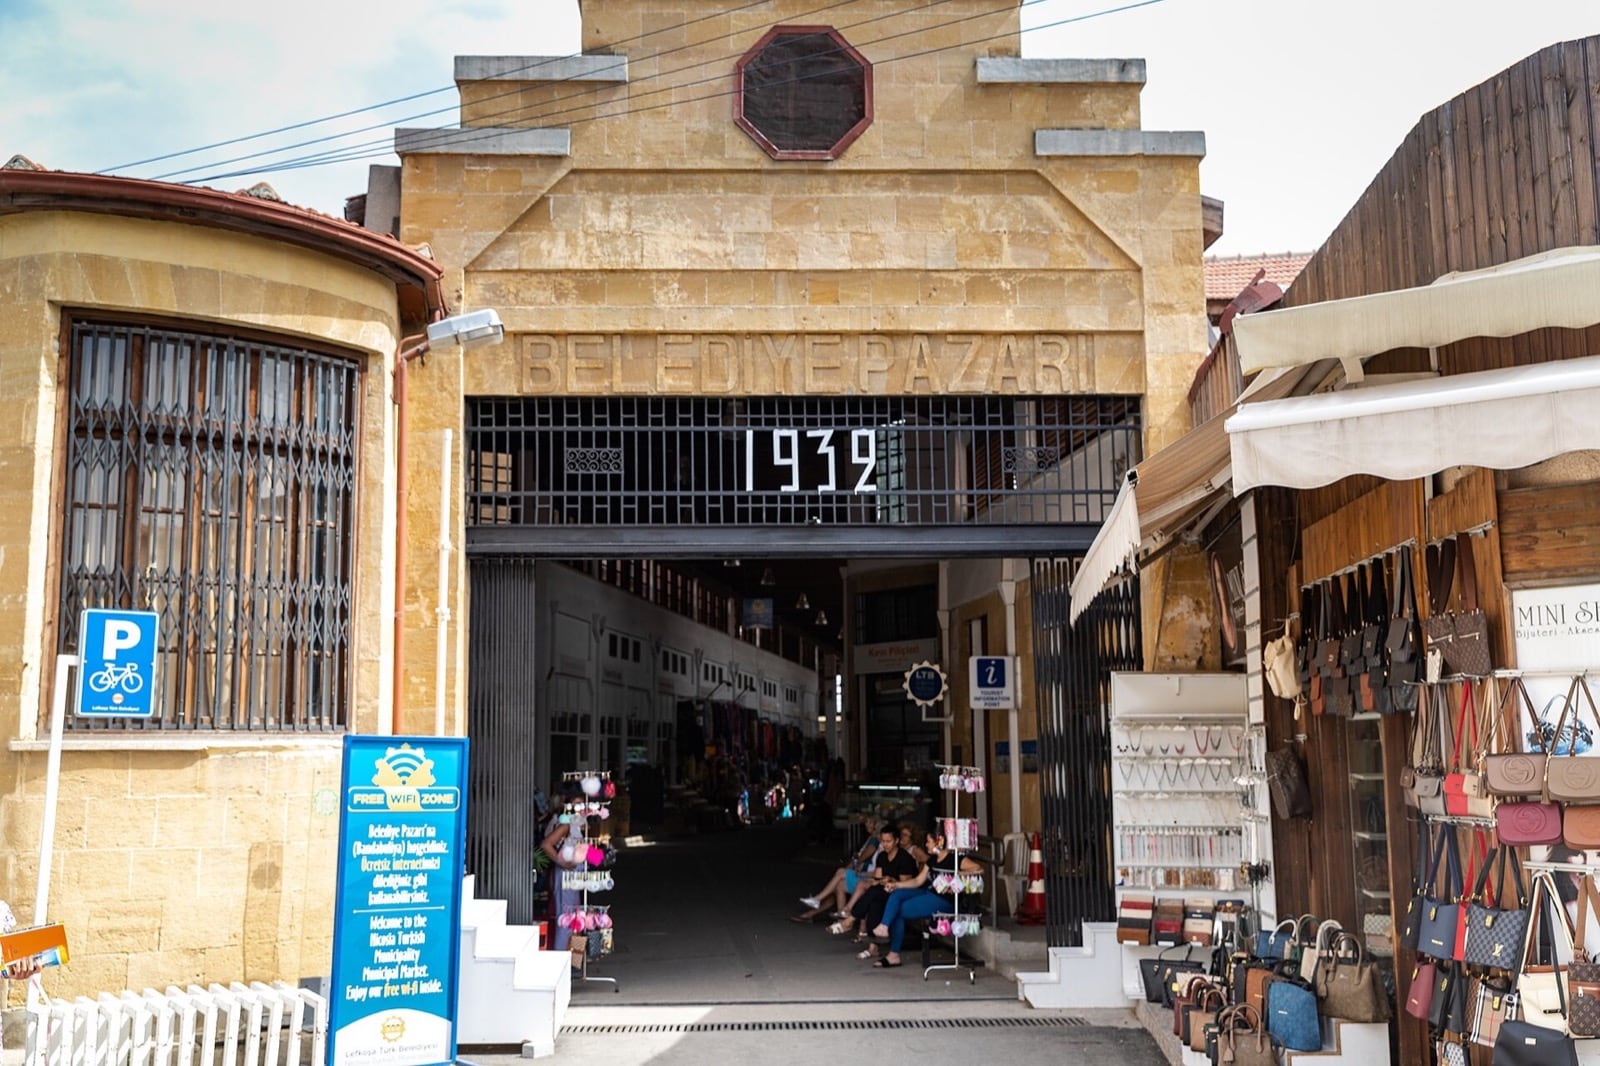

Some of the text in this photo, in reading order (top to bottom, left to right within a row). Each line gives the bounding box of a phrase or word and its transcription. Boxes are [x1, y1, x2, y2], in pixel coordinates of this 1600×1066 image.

[857, 333, 1093, 394] PAZARI
[1518, 604, 1566, 626] MINI
[103, 619, 141, 660] P
[353, 793, 454, 805] FREE WIFI ZONE
[370, 914, 427, 930] Welcome to the
[370, 930, 426, 947] Nicosia Turkish
[374, 948, 420, 964] Municipality
[362, 966, 399, 982] Municipal
[346, 985, 368, 1002] Enjoy
[369, 985, 382, 998] our
[384, 982, 399, 998] free
